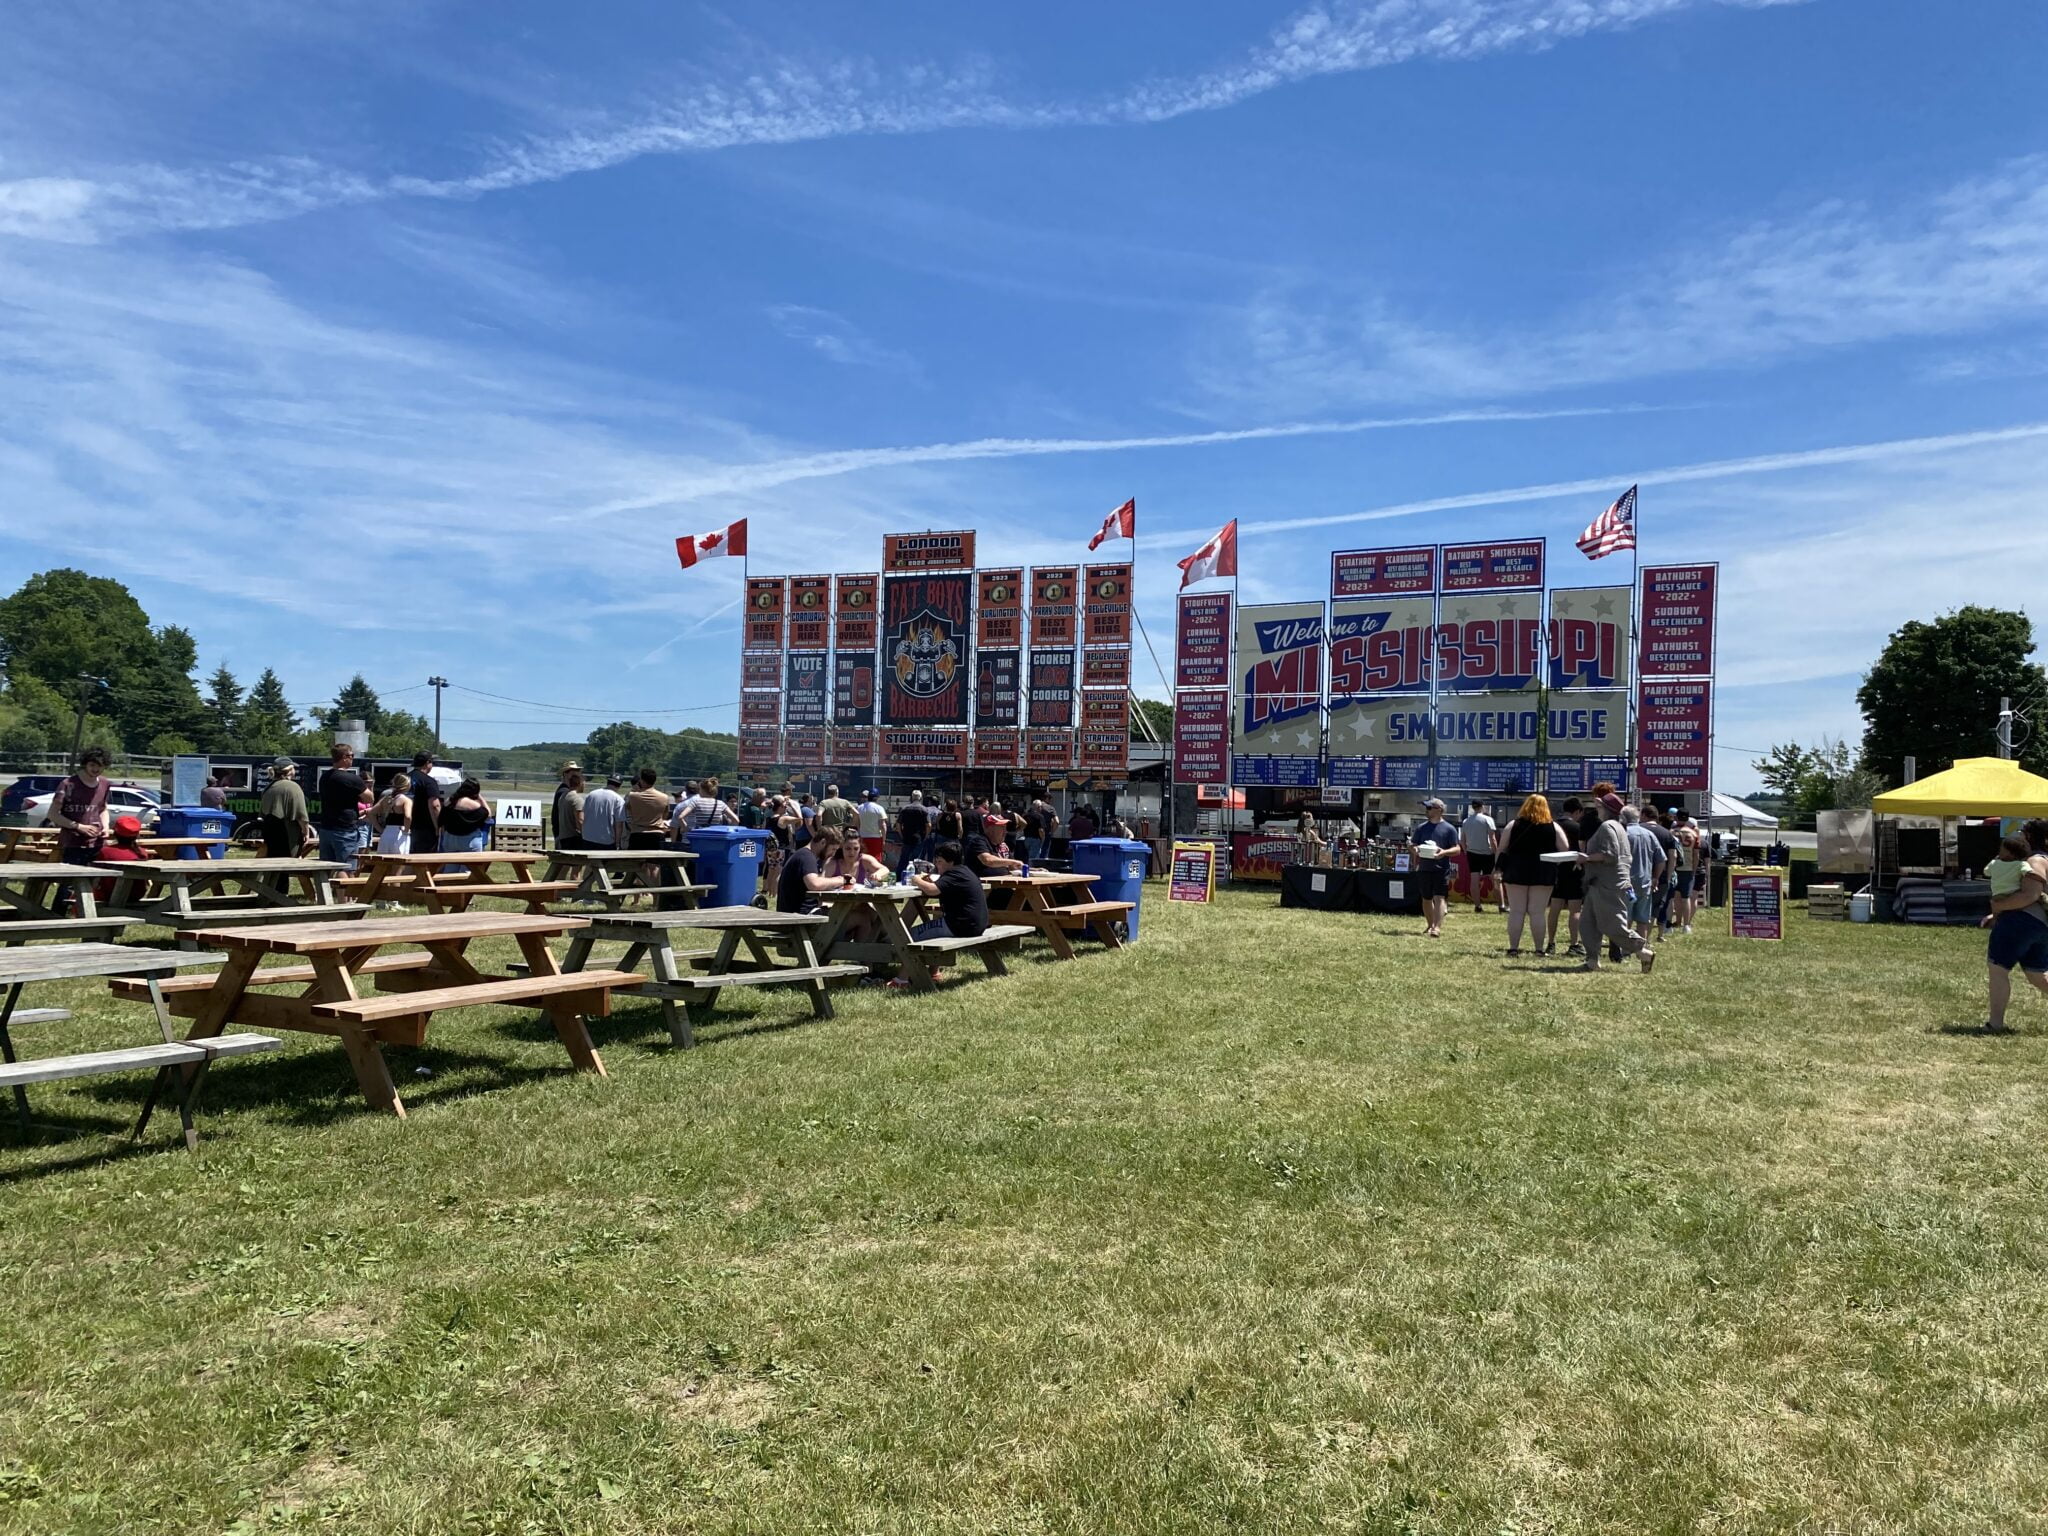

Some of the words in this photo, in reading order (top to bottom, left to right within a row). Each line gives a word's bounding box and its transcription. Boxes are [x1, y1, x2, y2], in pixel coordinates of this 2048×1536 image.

[895, 551, 923, 560] BEST
[926, 548, 964, 558] SAUCE
[1448, 550, 1484, 560] BATHURST
[1490, 548, 1516, 558] SMITHS
[1518, 546, 1538, 556] FALLS
[1340, 557, 1376, 567] STRATHROY
[1385, 554, 1428, 564] SCARBOROUGH
[1501, 574, 1525, 583] 2023
[1655, 571, 1702, 581] BATHURST
[1394, 580, 1417, 588] 2023
[1453, 577, 1477, 585] 2023
[1346, 583, 1367, 591] 2023
[1666, 592, 1690, 601] 2022
[889, 582, 921, 627] FAT
[927, 580, 964, 625] BOYS
[1185, 598, 1224, 608] STOUFFVILLE
[1034, 605, 1053, 617] PARRY
[1054, 605, 1073, 616] SOUND
[1088, 603, 1128, 614] BELLEVILLE
[1655, 606, 1700, 616] SUDBURY
[981, 608, 1018, 619] BURLINGTON
[987, 620, 1012, 628] BEST
[1040, 619, 1066, 627] BEST
[1094, 616, 1121, 625] BEST
[1362, 616, 1378, 632] to
[753, 624, 776, 632] BEST
[798, 623, 820, 631] BEST
[845, 623, 868, 631] BEST
[1040, 627, 1066, 636] RIBS
[1094, 625, 1120, 634] RIBS
[753, 632, 775, 640] RIBS
[798, 632, 820, 640] RIBS
[838, 631, 872, 640] OVERALL
[987, 628, 1011, 637] RIBS
[1187, 628, 1220, 636] CORNWALL
[1664, 628, 1687, 636] 2019
[1652, 642, 1699, 651] BATHURST
[1034, 654, 1071, 665] COOKED
[1086, 652, 1128, 662] BELLEVILLE
[793, 657, 822, 671] VOTE
[839, 661, 854, 669] TAKE
[997, 659, 1013, 668] TAKE
[1181, 658, 1211, 666] BRANDON
[1250, 618, 1616, 723] MISSISSIPPI
[1663, 663, 1686, 671] 2019
[838, 676, 850, 685] OUR
[996, 675, 1009, 684] OUR
[1034, 666, 1070, 686] LOW
[1644, 686, 1673, 695] PARRY
[1674, 685, 1704, 695] SOUND
[838, 692, 850, 701] RUB
[890, 681, 960, 718] BARBECUE
[996, 692, 1016, 701] SAUCE
[1032, 690, 1070, 700] COOKED
[1085, 692, 1126, 702] BELLEVILLE
[1213, 694, 1223, 702] MB
[838, 708, 846, 717] TO
[848, 708, 856, 717] GO
[996, 708, 1004, 717] TO
[1006, 708, 1014, 717] GO
[1032, 702, 1070, 723] SLOW
[1661, 707, 1685, 715] 2022
[1192, 712, 1210, 720] 2022
[1180, 724, 1223, 732] SHERBROOKE
[1389, 709, 1608, 742] SMOKEHOUSE
[1647, 721, 1699, 730] STRATHROY
[885, 733, 962, 745] STOUFFVILLE
[1084, 733, 1124, 743] STRATHROY
[1674, 732, 1692, 740] RIBS
[892, 745, 920, 754] BEST
[924, 745, 954, 753] RIBS
[1660, 742, 1685, 750] 2022
[1184, 754, 1218, 762] BATHURST
[1643, 756, 1703, 765] SCARBOROUGH
[505, 805, 532, 820] ATM
